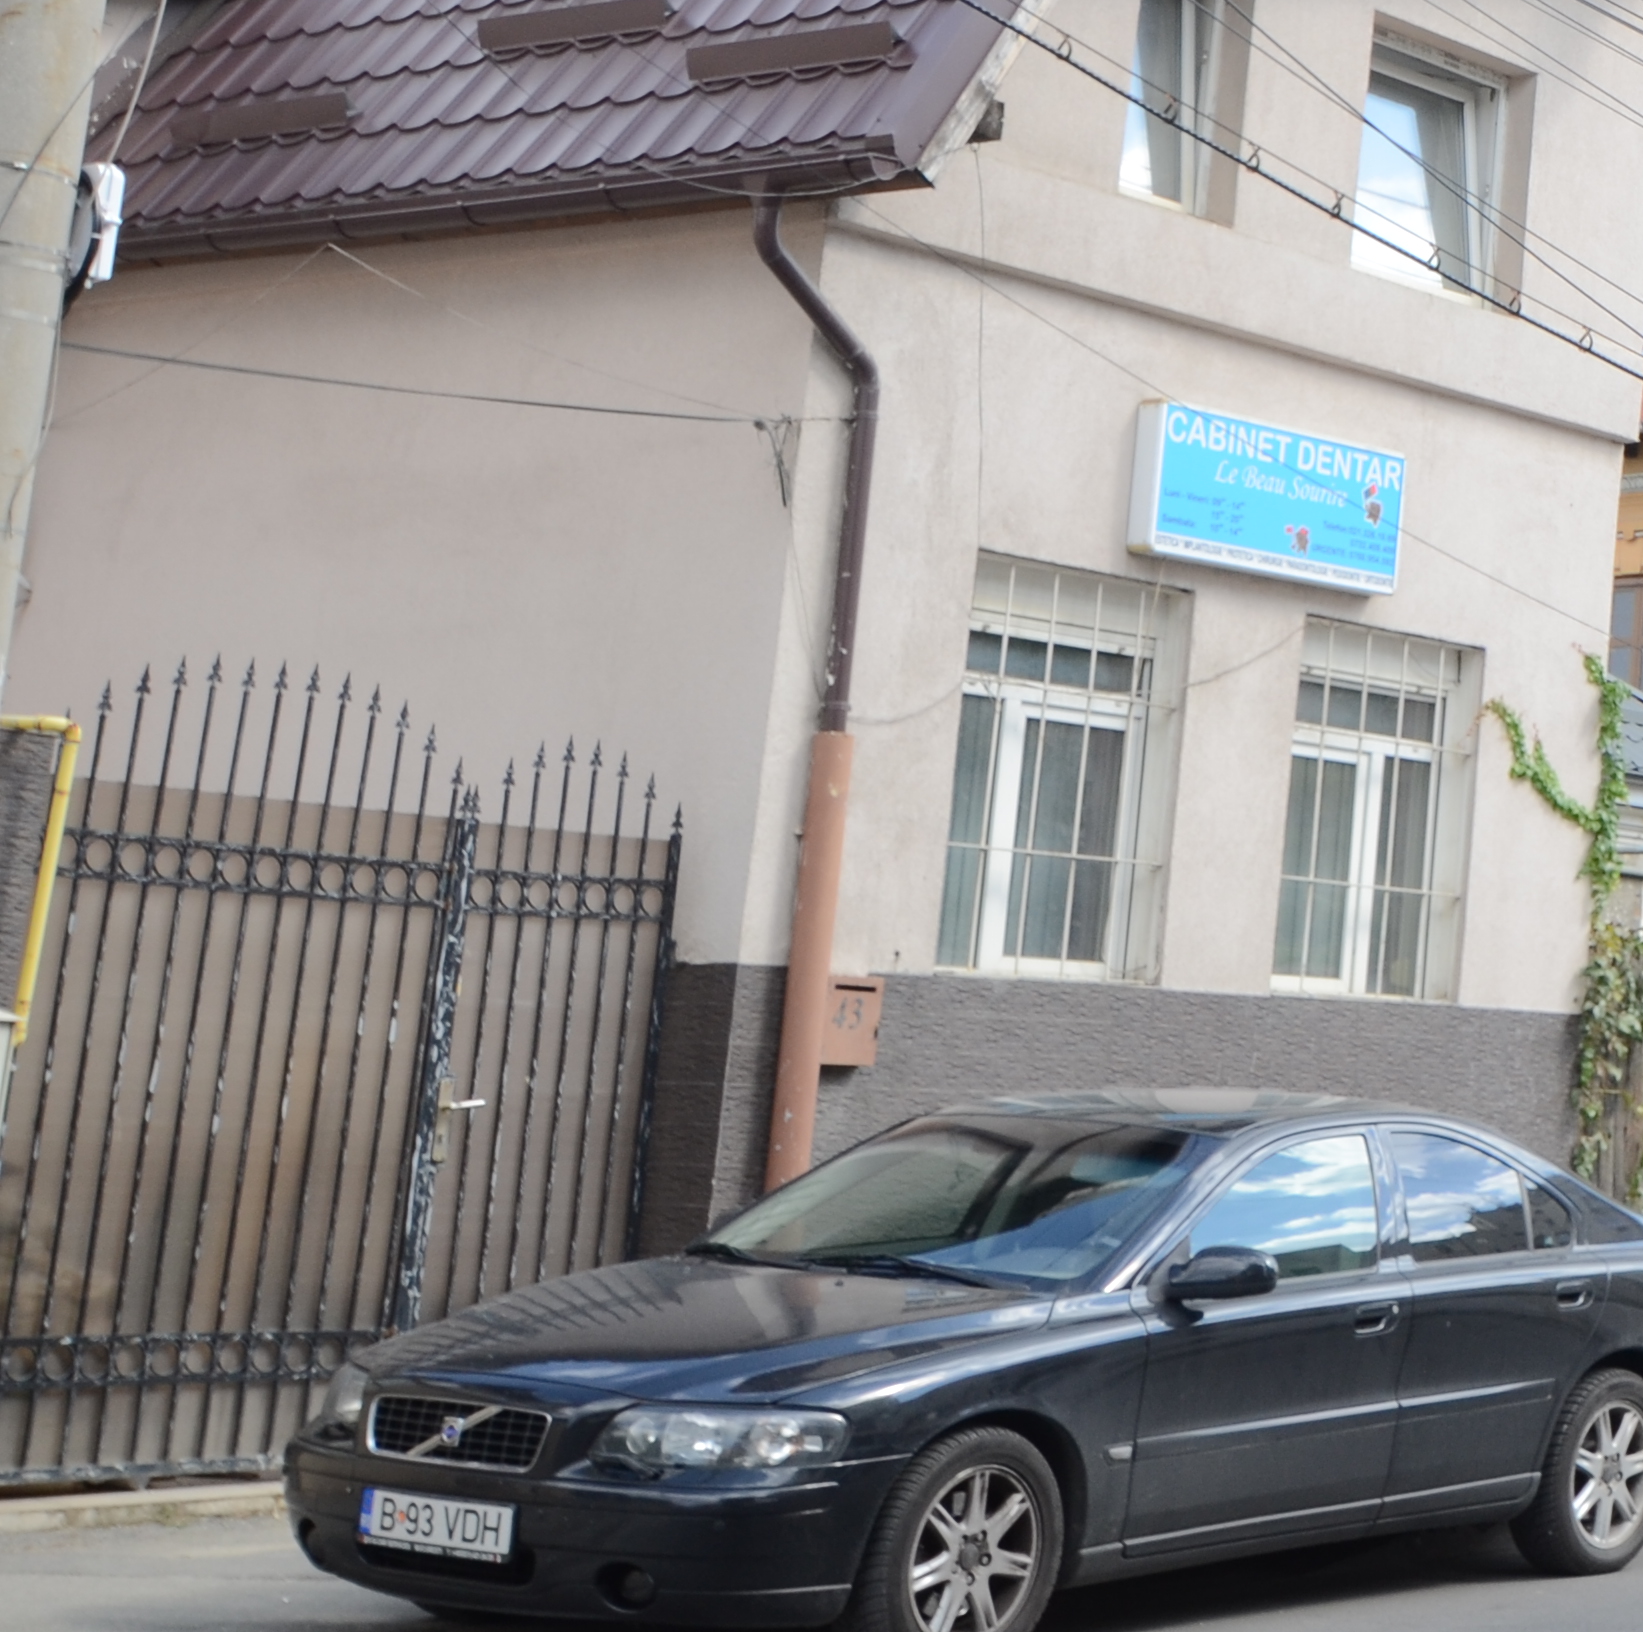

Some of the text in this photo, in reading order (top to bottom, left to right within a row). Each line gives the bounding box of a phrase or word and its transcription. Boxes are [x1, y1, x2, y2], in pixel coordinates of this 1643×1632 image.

[1167, 410, 1402, 491] CABINET DENTAR
[1213, 459, 1348, 509] Le Beau Sourire
[831, 996, 865, 1030] 43
[380, 1497, 502, 1548] B 93 VDH
